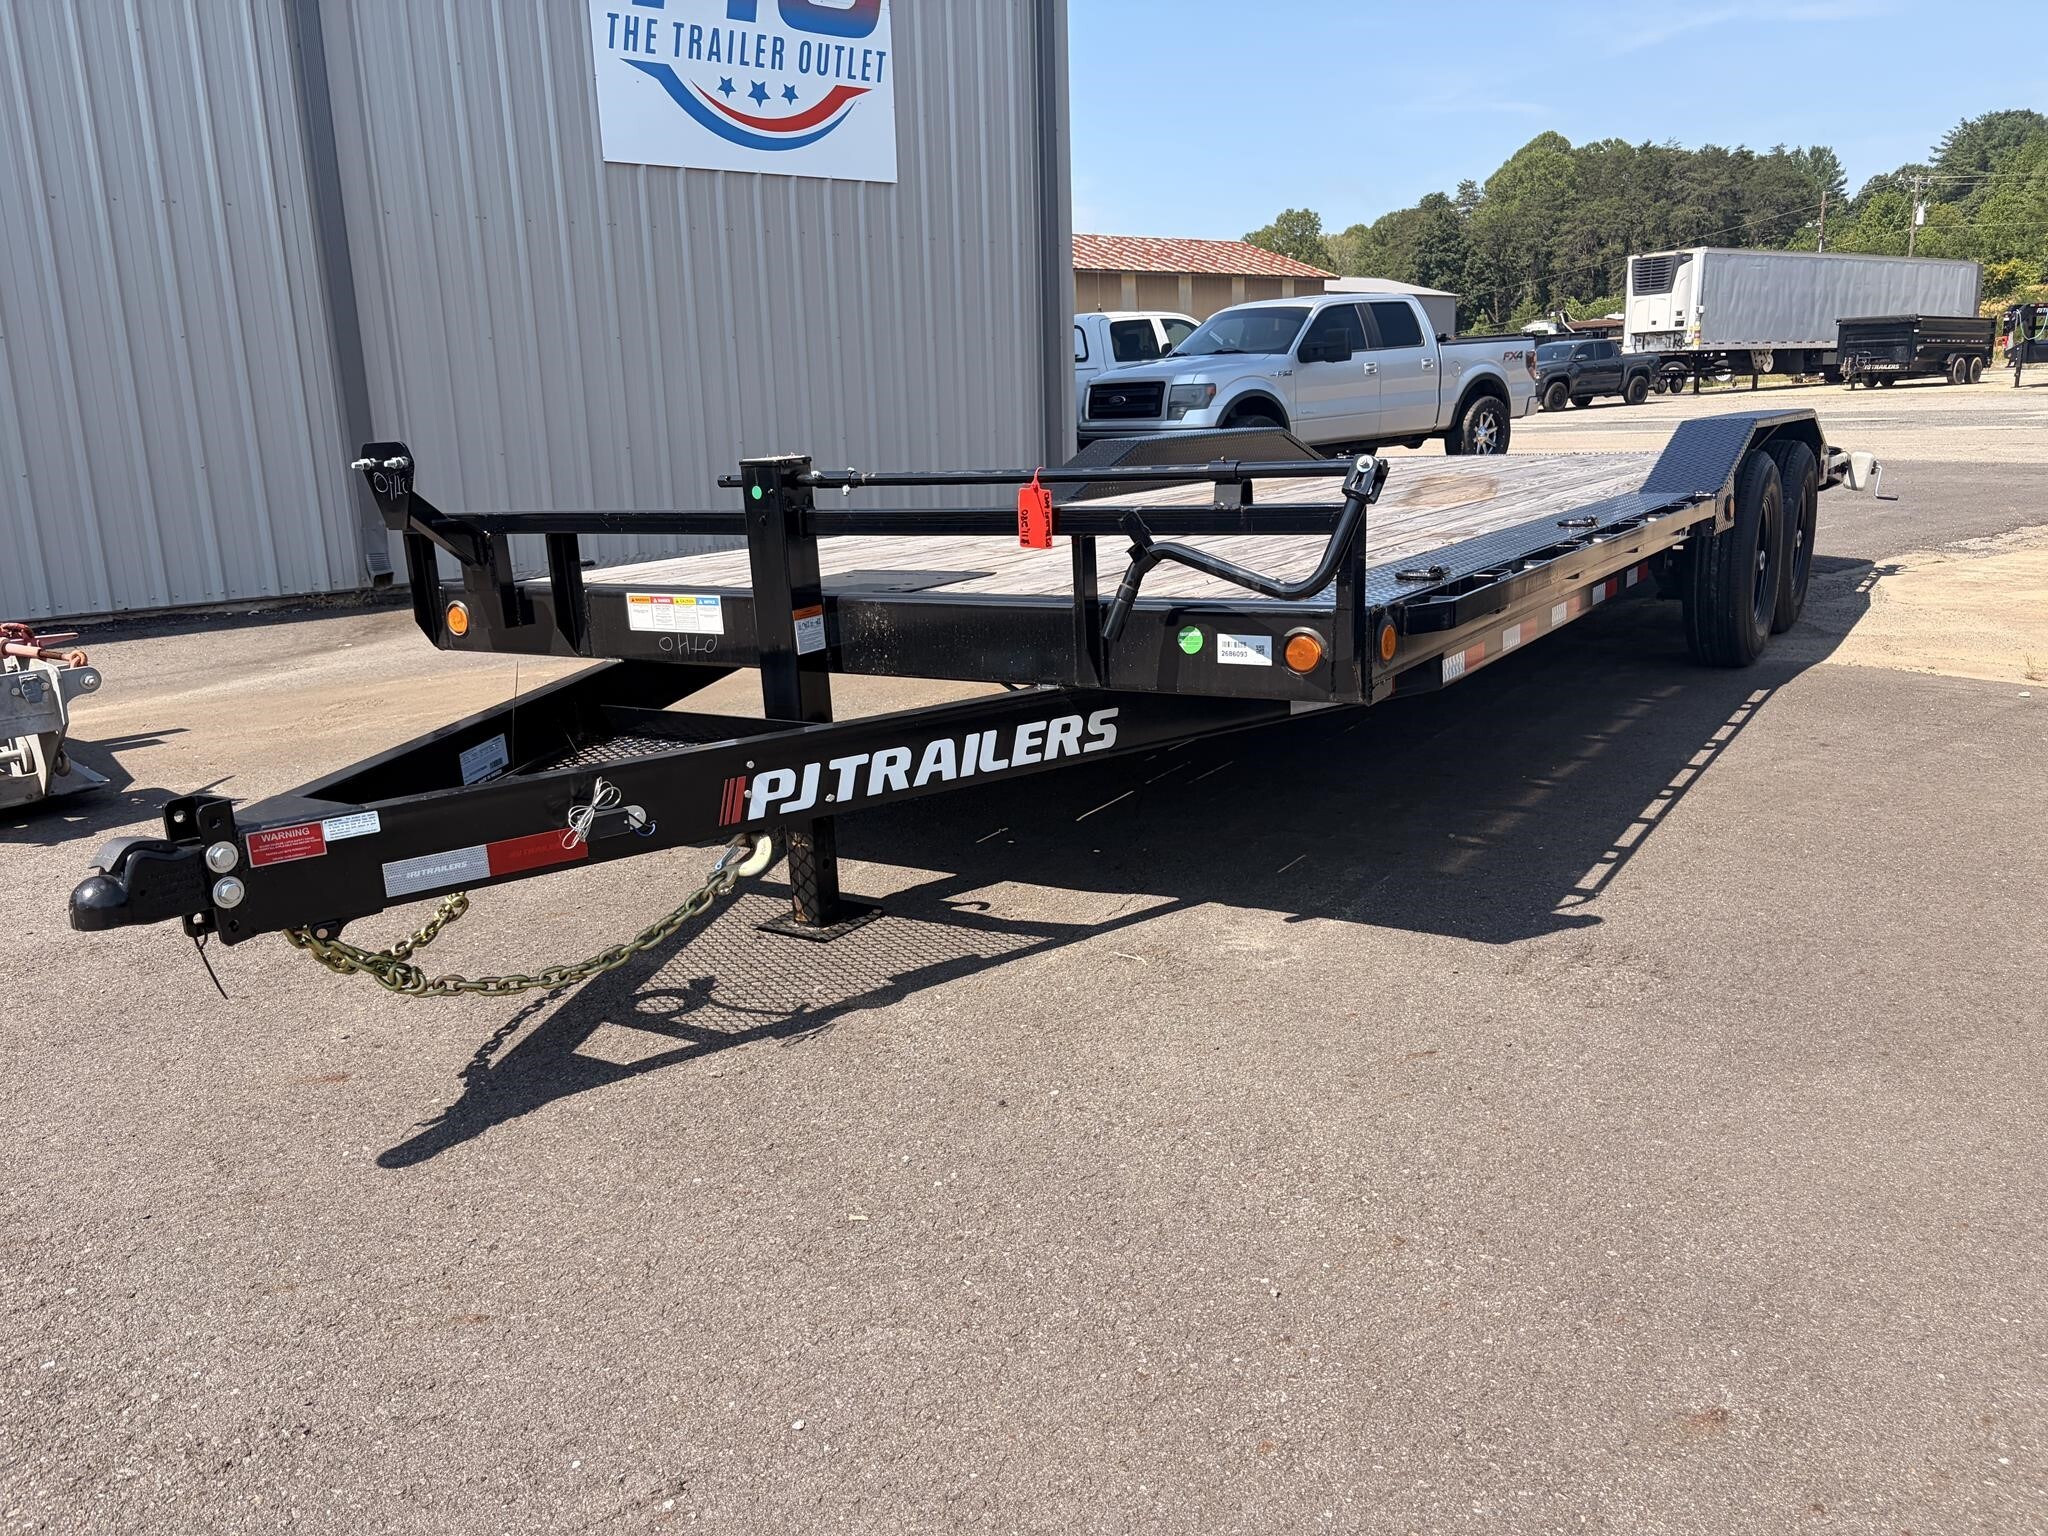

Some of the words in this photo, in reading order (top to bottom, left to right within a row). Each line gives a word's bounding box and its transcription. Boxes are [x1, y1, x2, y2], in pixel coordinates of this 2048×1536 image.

[606, 12, 658, 55] THE
[672, 22, 785, 71] TRAILER
[798, 40, 887, 83] OUTLET
[1503, 351, 1523, 361] FX4
[1221, 650, 1248, 658] 2686093
[748, 763, 821, 821] PJ
[829, 707, 1119, 803] TRAILERS
[261, 828, 310, 843] WARNING
[420, 861, 468, 876] TRAILERS
